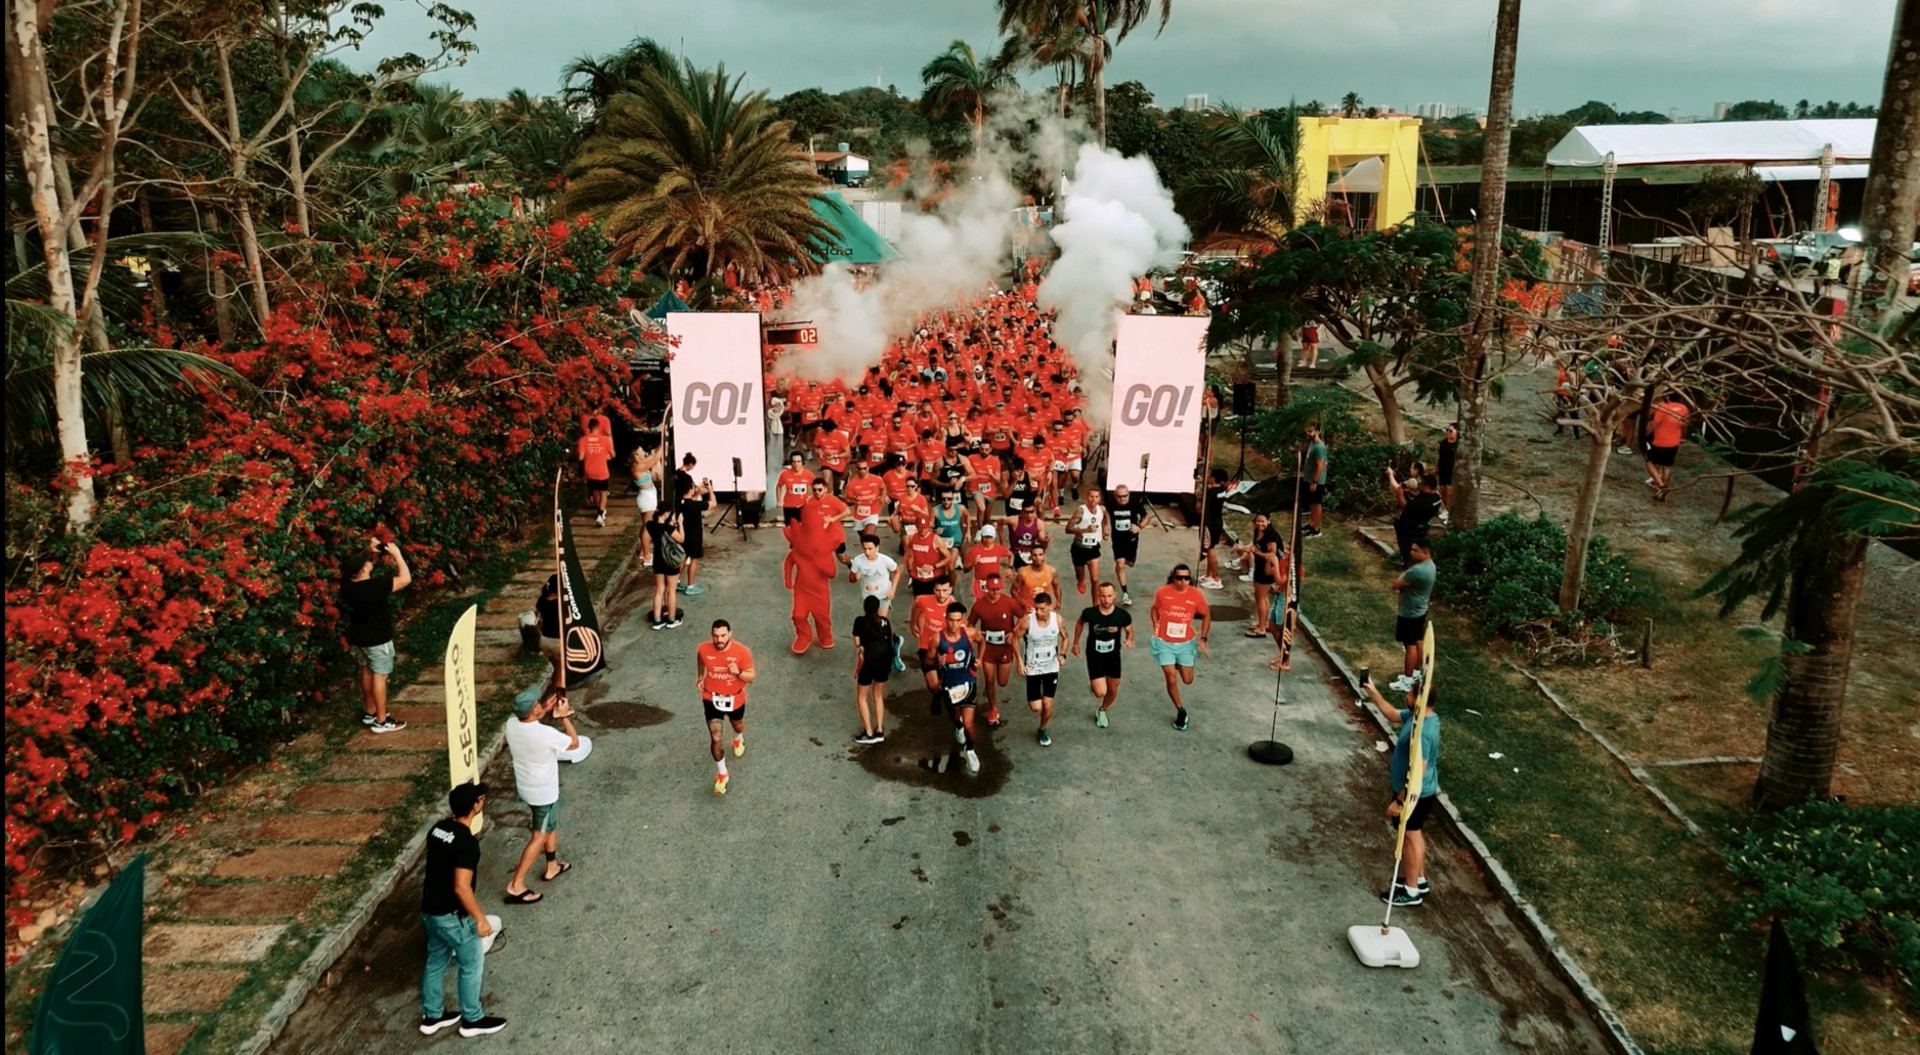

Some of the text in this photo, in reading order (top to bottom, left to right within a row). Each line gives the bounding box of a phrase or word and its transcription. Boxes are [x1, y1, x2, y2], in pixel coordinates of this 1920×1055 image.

[800, 329, 816, 343] 02
[682, 381, 753, 426] GO!
[1120, 383, 1194, 428] GO!
[451, 643, 474, 768] SEGURO
